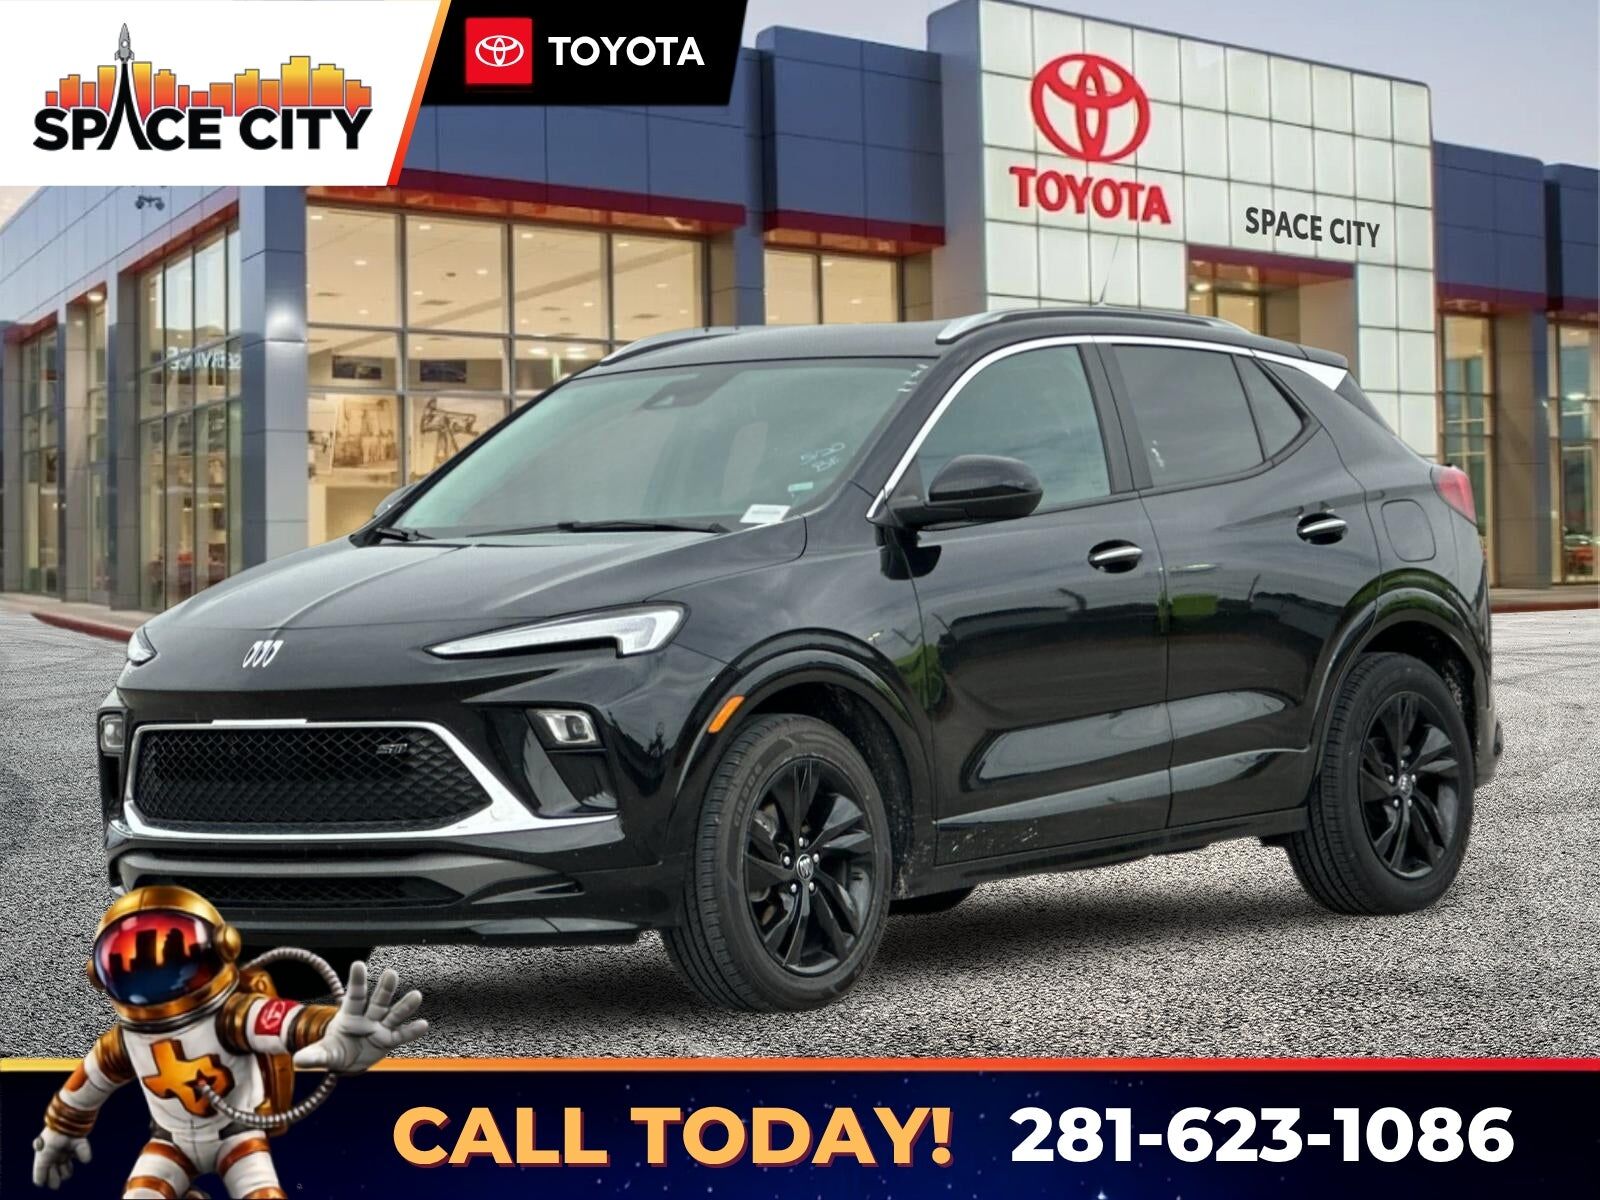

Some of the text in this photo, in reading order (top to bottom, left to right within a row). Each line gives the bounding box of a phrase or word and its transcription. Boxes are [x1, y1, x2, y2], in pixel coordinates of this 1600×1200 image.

[1009, 166, 1171, 225] TOYOTA
[1245, 206, 1381, 248] SPACE CITY
